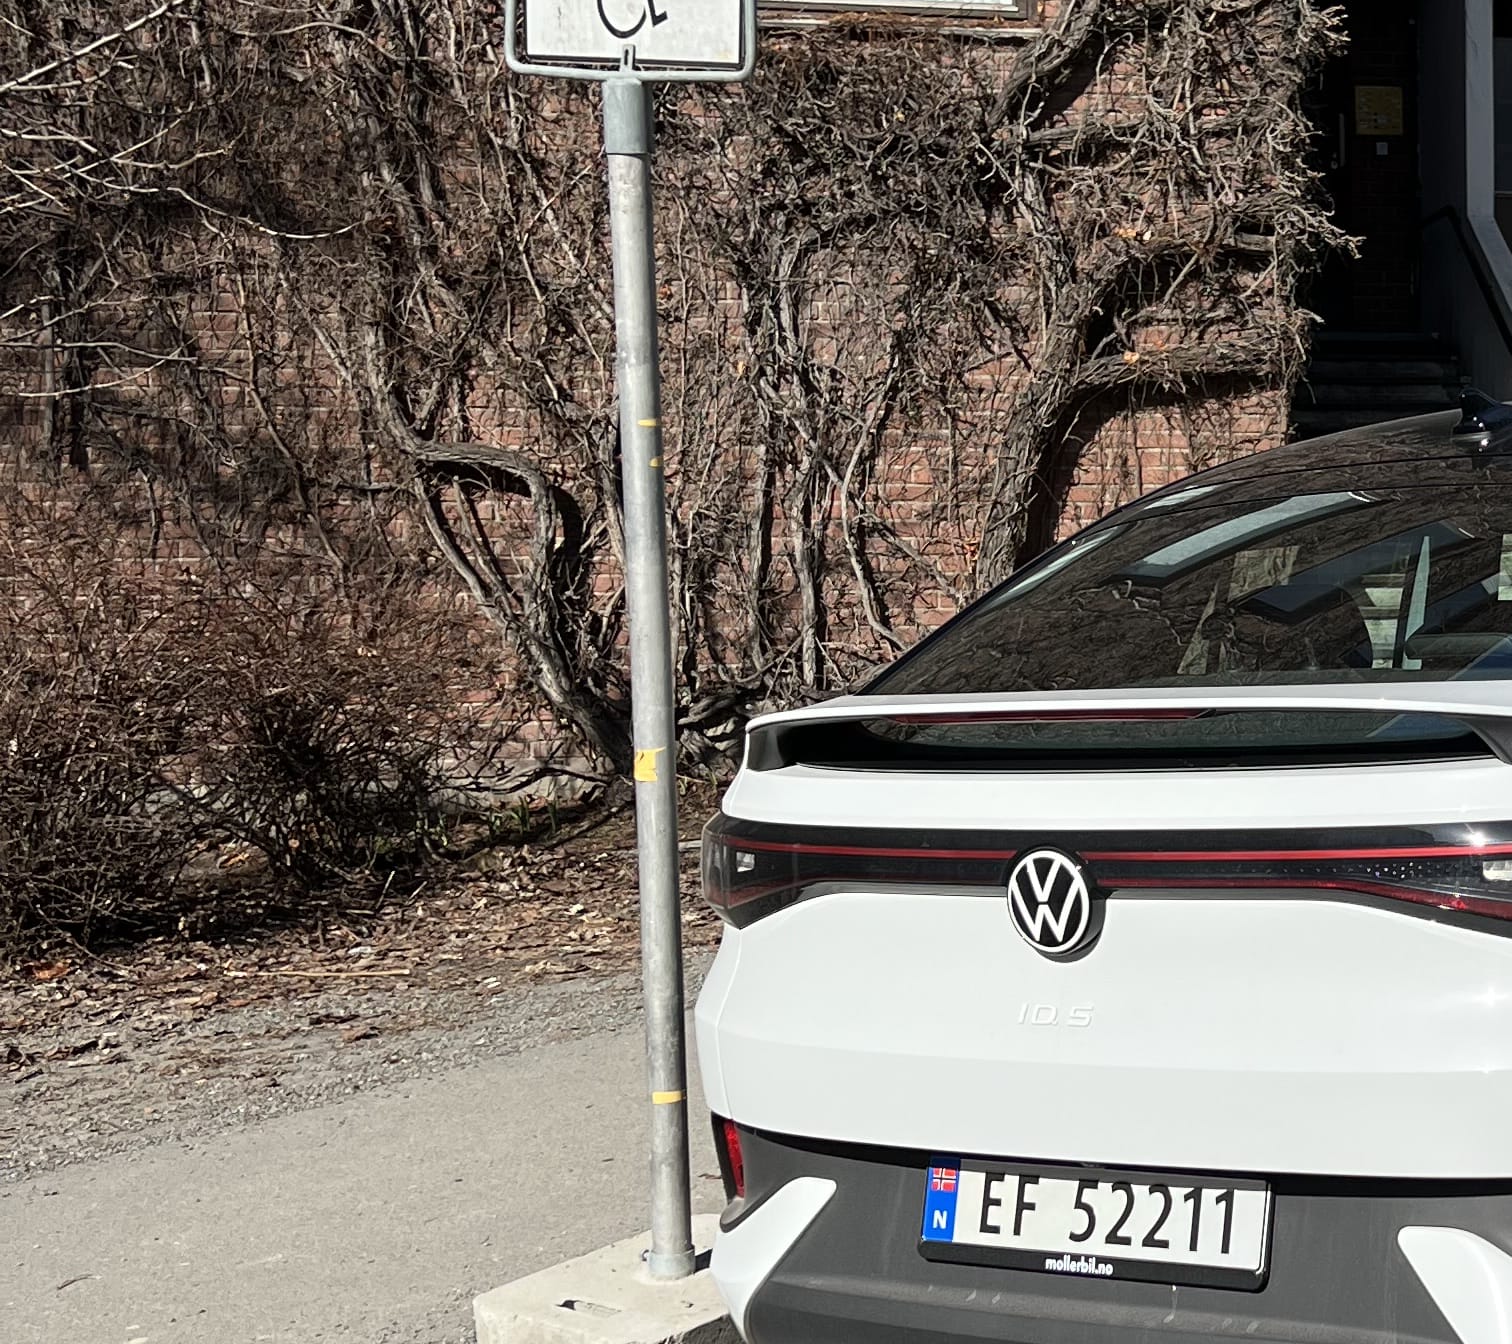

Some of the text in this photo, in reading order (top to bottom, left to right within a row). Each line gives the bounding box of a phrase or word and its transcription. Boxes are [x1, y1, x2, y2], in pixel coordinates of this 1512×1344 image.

[932, 1209, 947, 1230] N
[978, 1171, 1236, 1255] EF 52211
[1045, 1254, 1114, 1276] mollerbil.no
